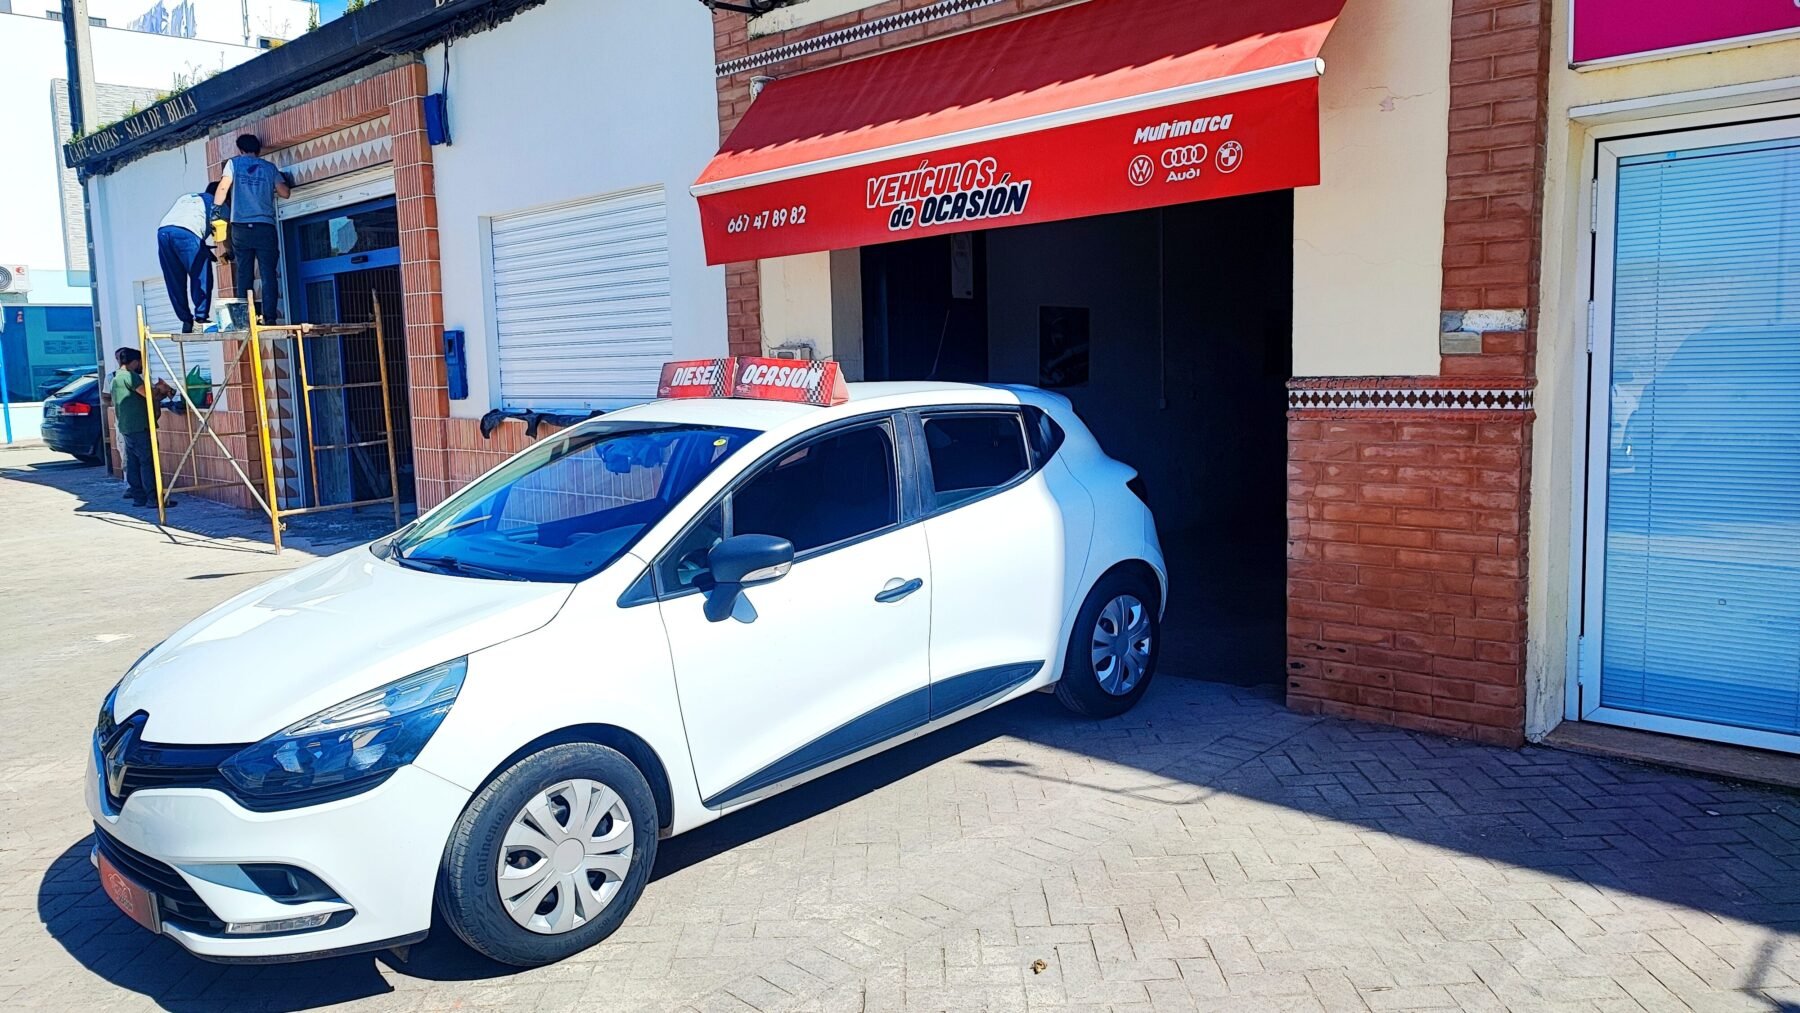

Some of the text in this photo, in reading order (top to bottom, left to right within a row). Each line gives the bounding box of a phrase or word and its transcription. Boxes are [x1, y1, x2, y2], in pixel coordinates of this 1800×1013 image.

[92, 128, 121, 153] COPAS
[164, 94, 198, 123] BILLA
[1133, 113, 1233, 145] Multimarca
[867, 158, 997, 208] VEHÍCULOS
[1166, 168, 1201, 183] Audi
[752, 210, 770, 230] 47
[772, 208, 788, 227] 89
[789, 205, 807, 224] 82
[888, 172, 1032, 231] de OCASIÓN
[671, 365, 719, 387] DIESEL
[741, 364, 824, 390] OCASION
[473, 807, 507, 888] Continental
